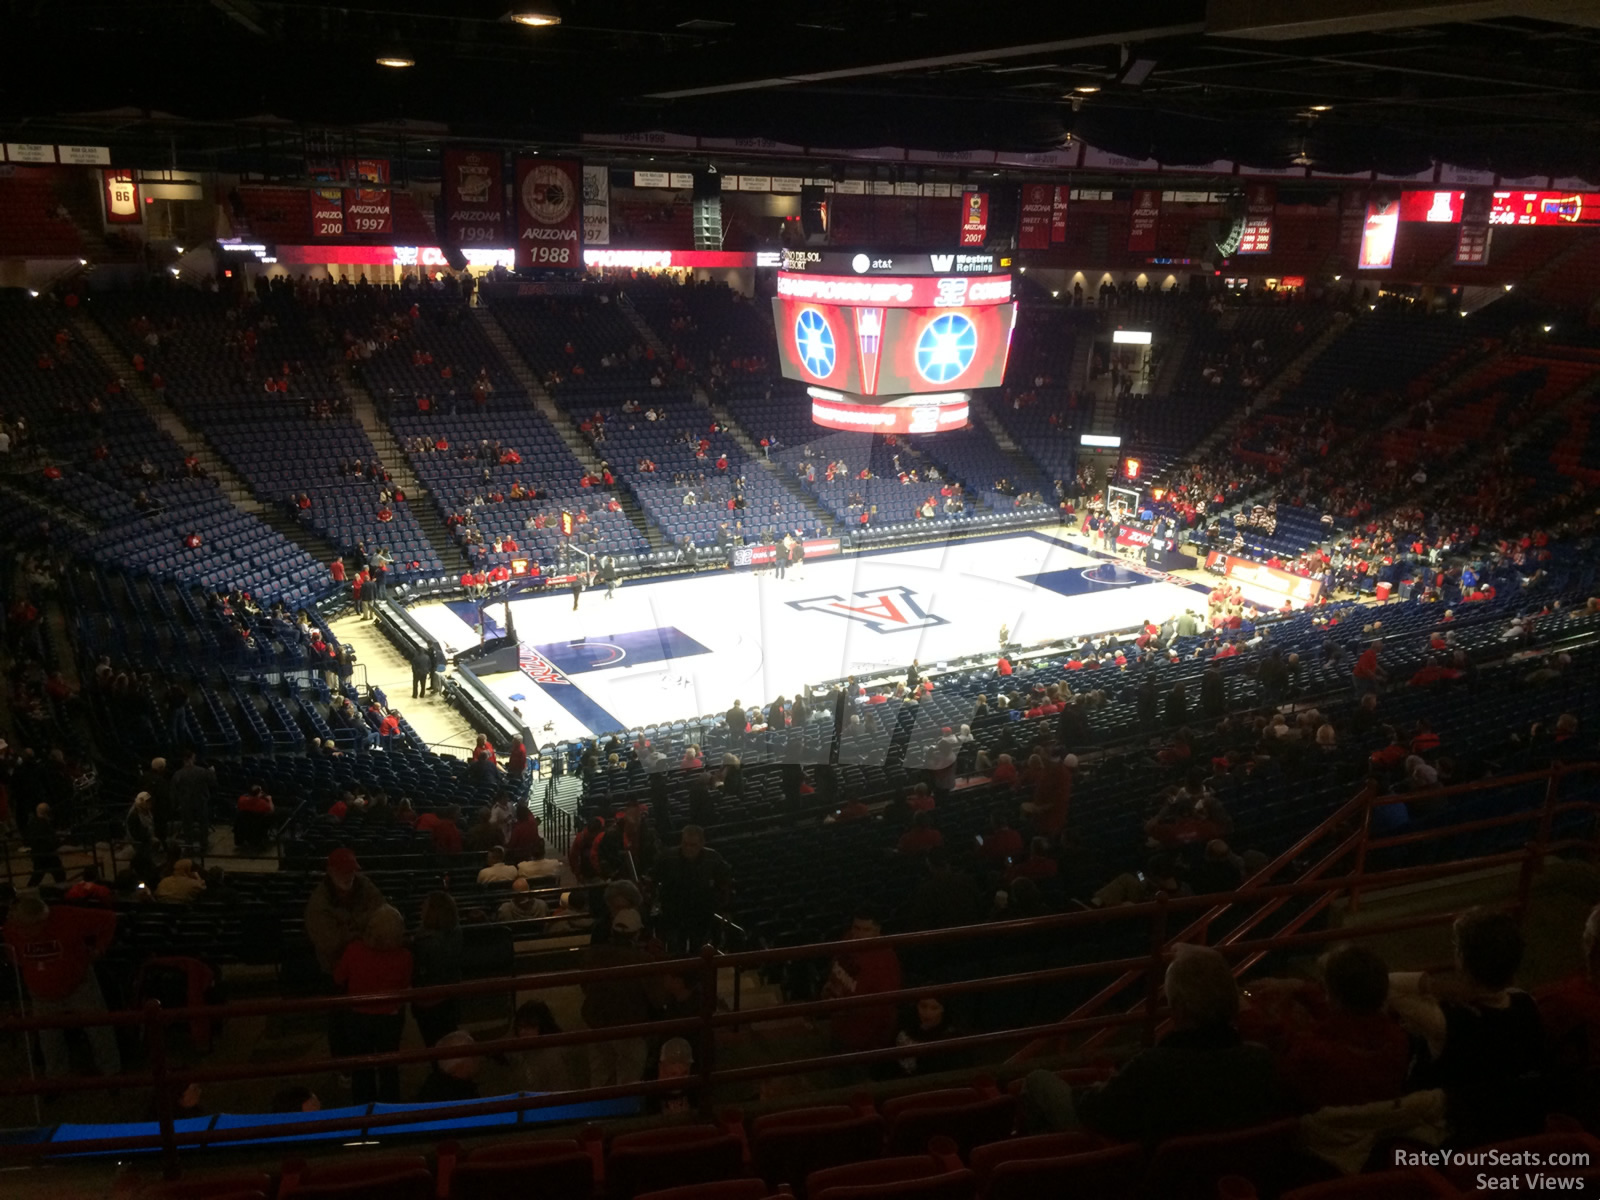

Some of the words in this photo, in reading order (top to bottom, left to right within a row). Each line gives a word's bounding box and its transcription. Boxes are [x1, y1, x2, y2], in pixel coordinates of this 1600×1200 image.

[115, 191, 130, 202] 86
[315, 210, 343, 219] ARIZO
[348, 205, 390, 214] ARIZONA
[450, 211, 500, 222] ARIZONA
[354, 218, 385, 230] 1997
[962, 223, 986, 231] ARIZONA
[458, 227, 495, 241] 1994
[521, 227, 578, 240] ARIZONA
[964, 233, 982, 243] 2001
[530, 247, 570, 264] 1988
[806, 252, 822, 263] SOL
[956, 254, 994, 264] Western
[872, 259, 893, 269] at&t
[956, 263, 993, 273] Refining
